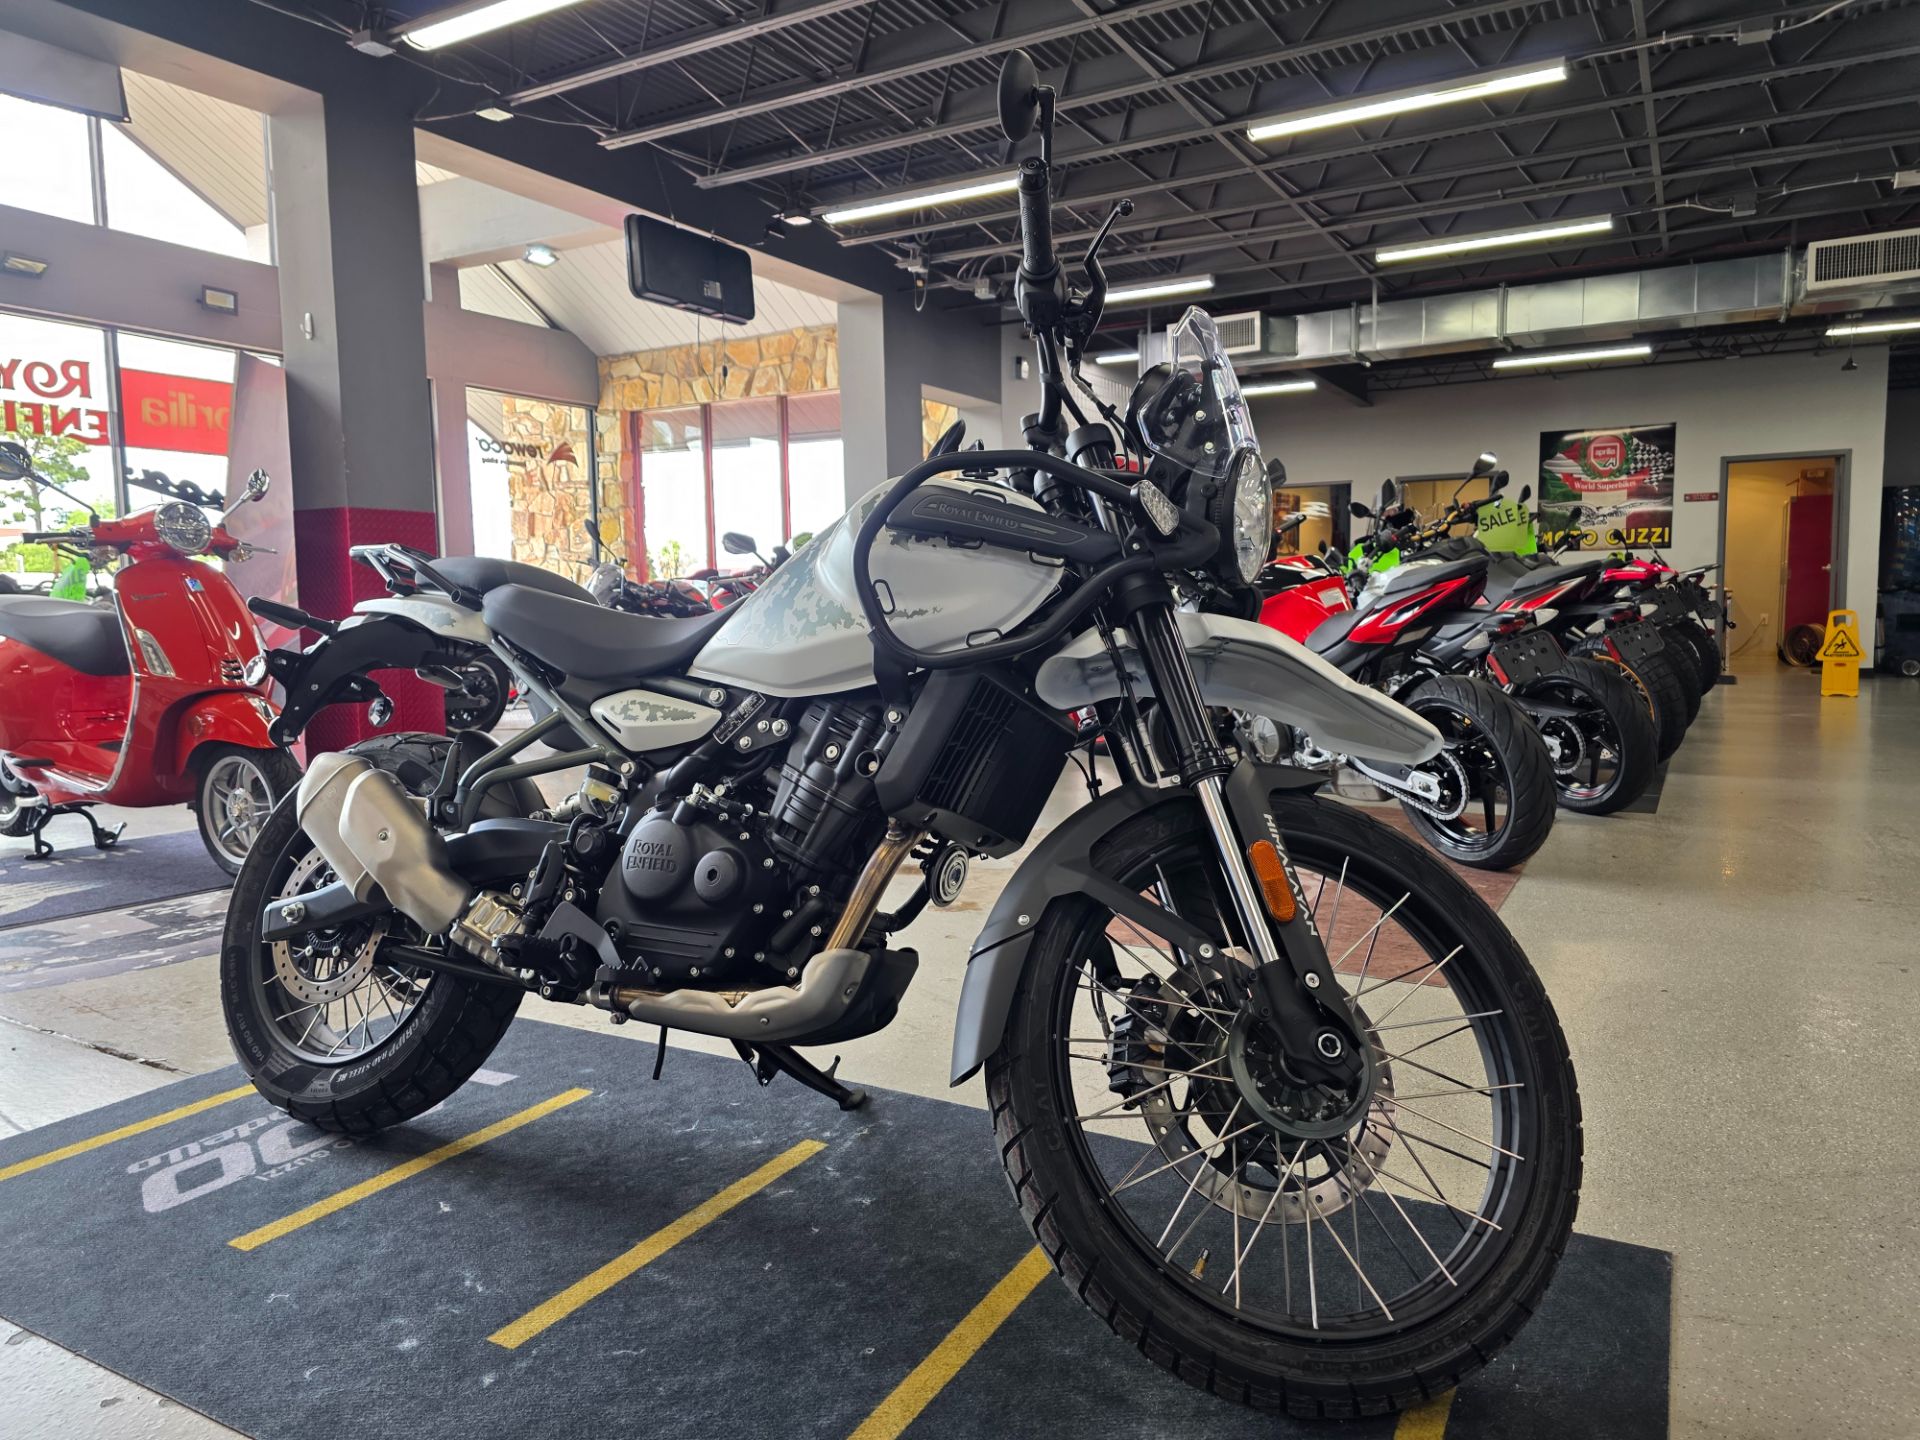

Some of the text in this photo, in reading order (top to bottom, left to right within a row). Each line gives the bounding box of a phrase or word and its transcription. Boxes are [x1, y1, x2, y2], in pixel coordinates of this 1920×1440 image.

[1574, 480, 1637, 491] World Superbikes
[939, 503, 1019, 529] ROYAL ENFIELD
[1480, 508, 1516, 532] SALE
[632, 839, 674, 857] ROYAL
[626, 855, 679, 874] ENFIELD
[255, 1149, 331, 1182] GUZZI
